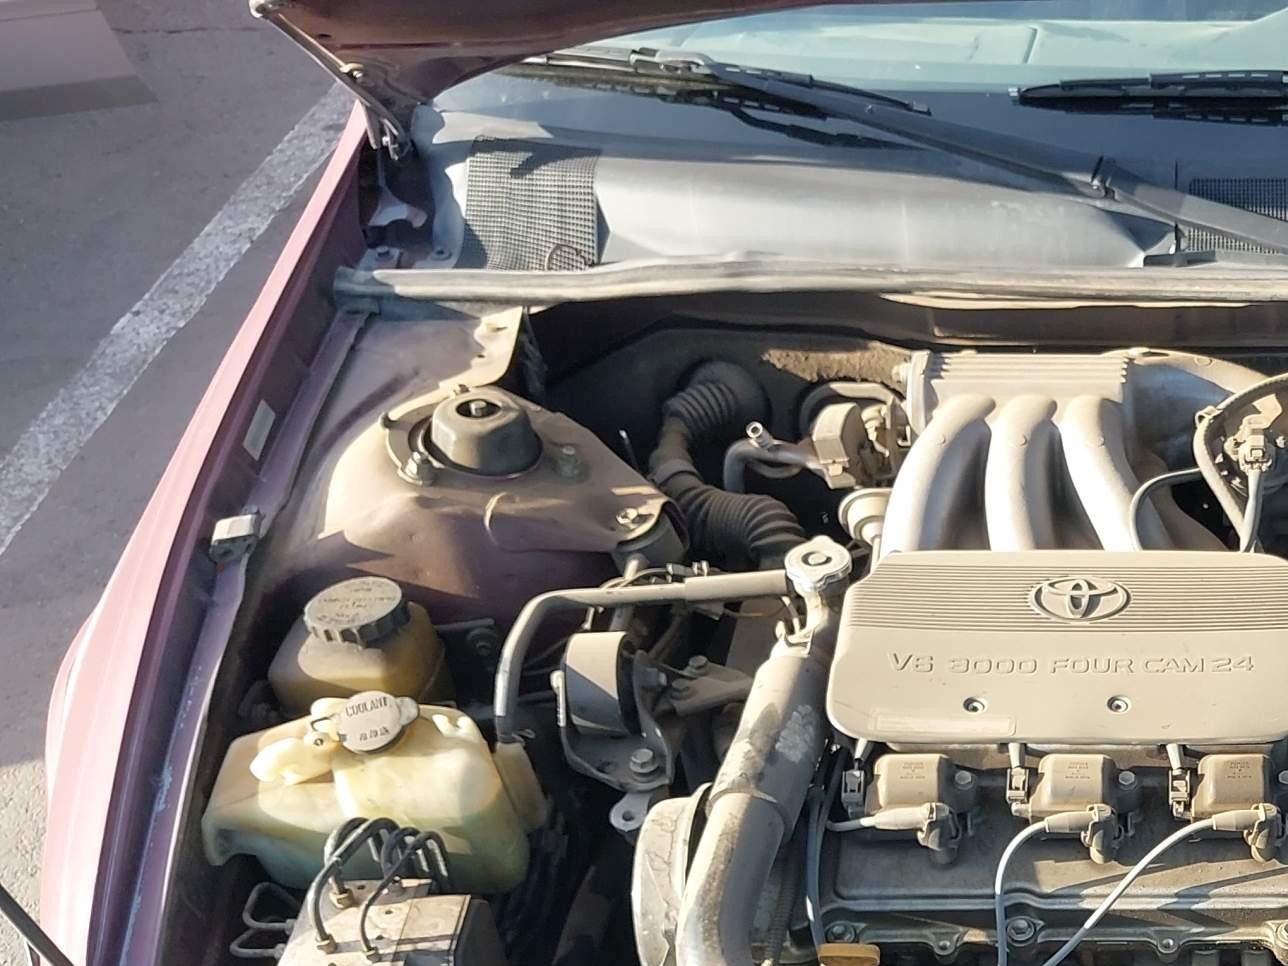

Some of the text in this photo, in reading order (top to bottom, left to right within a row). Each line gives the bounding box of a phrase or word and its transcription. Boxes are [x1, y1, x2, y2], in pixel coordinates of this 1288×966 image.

[890, 653, 1255, 674] V6 3000 FOUR CAM 24
